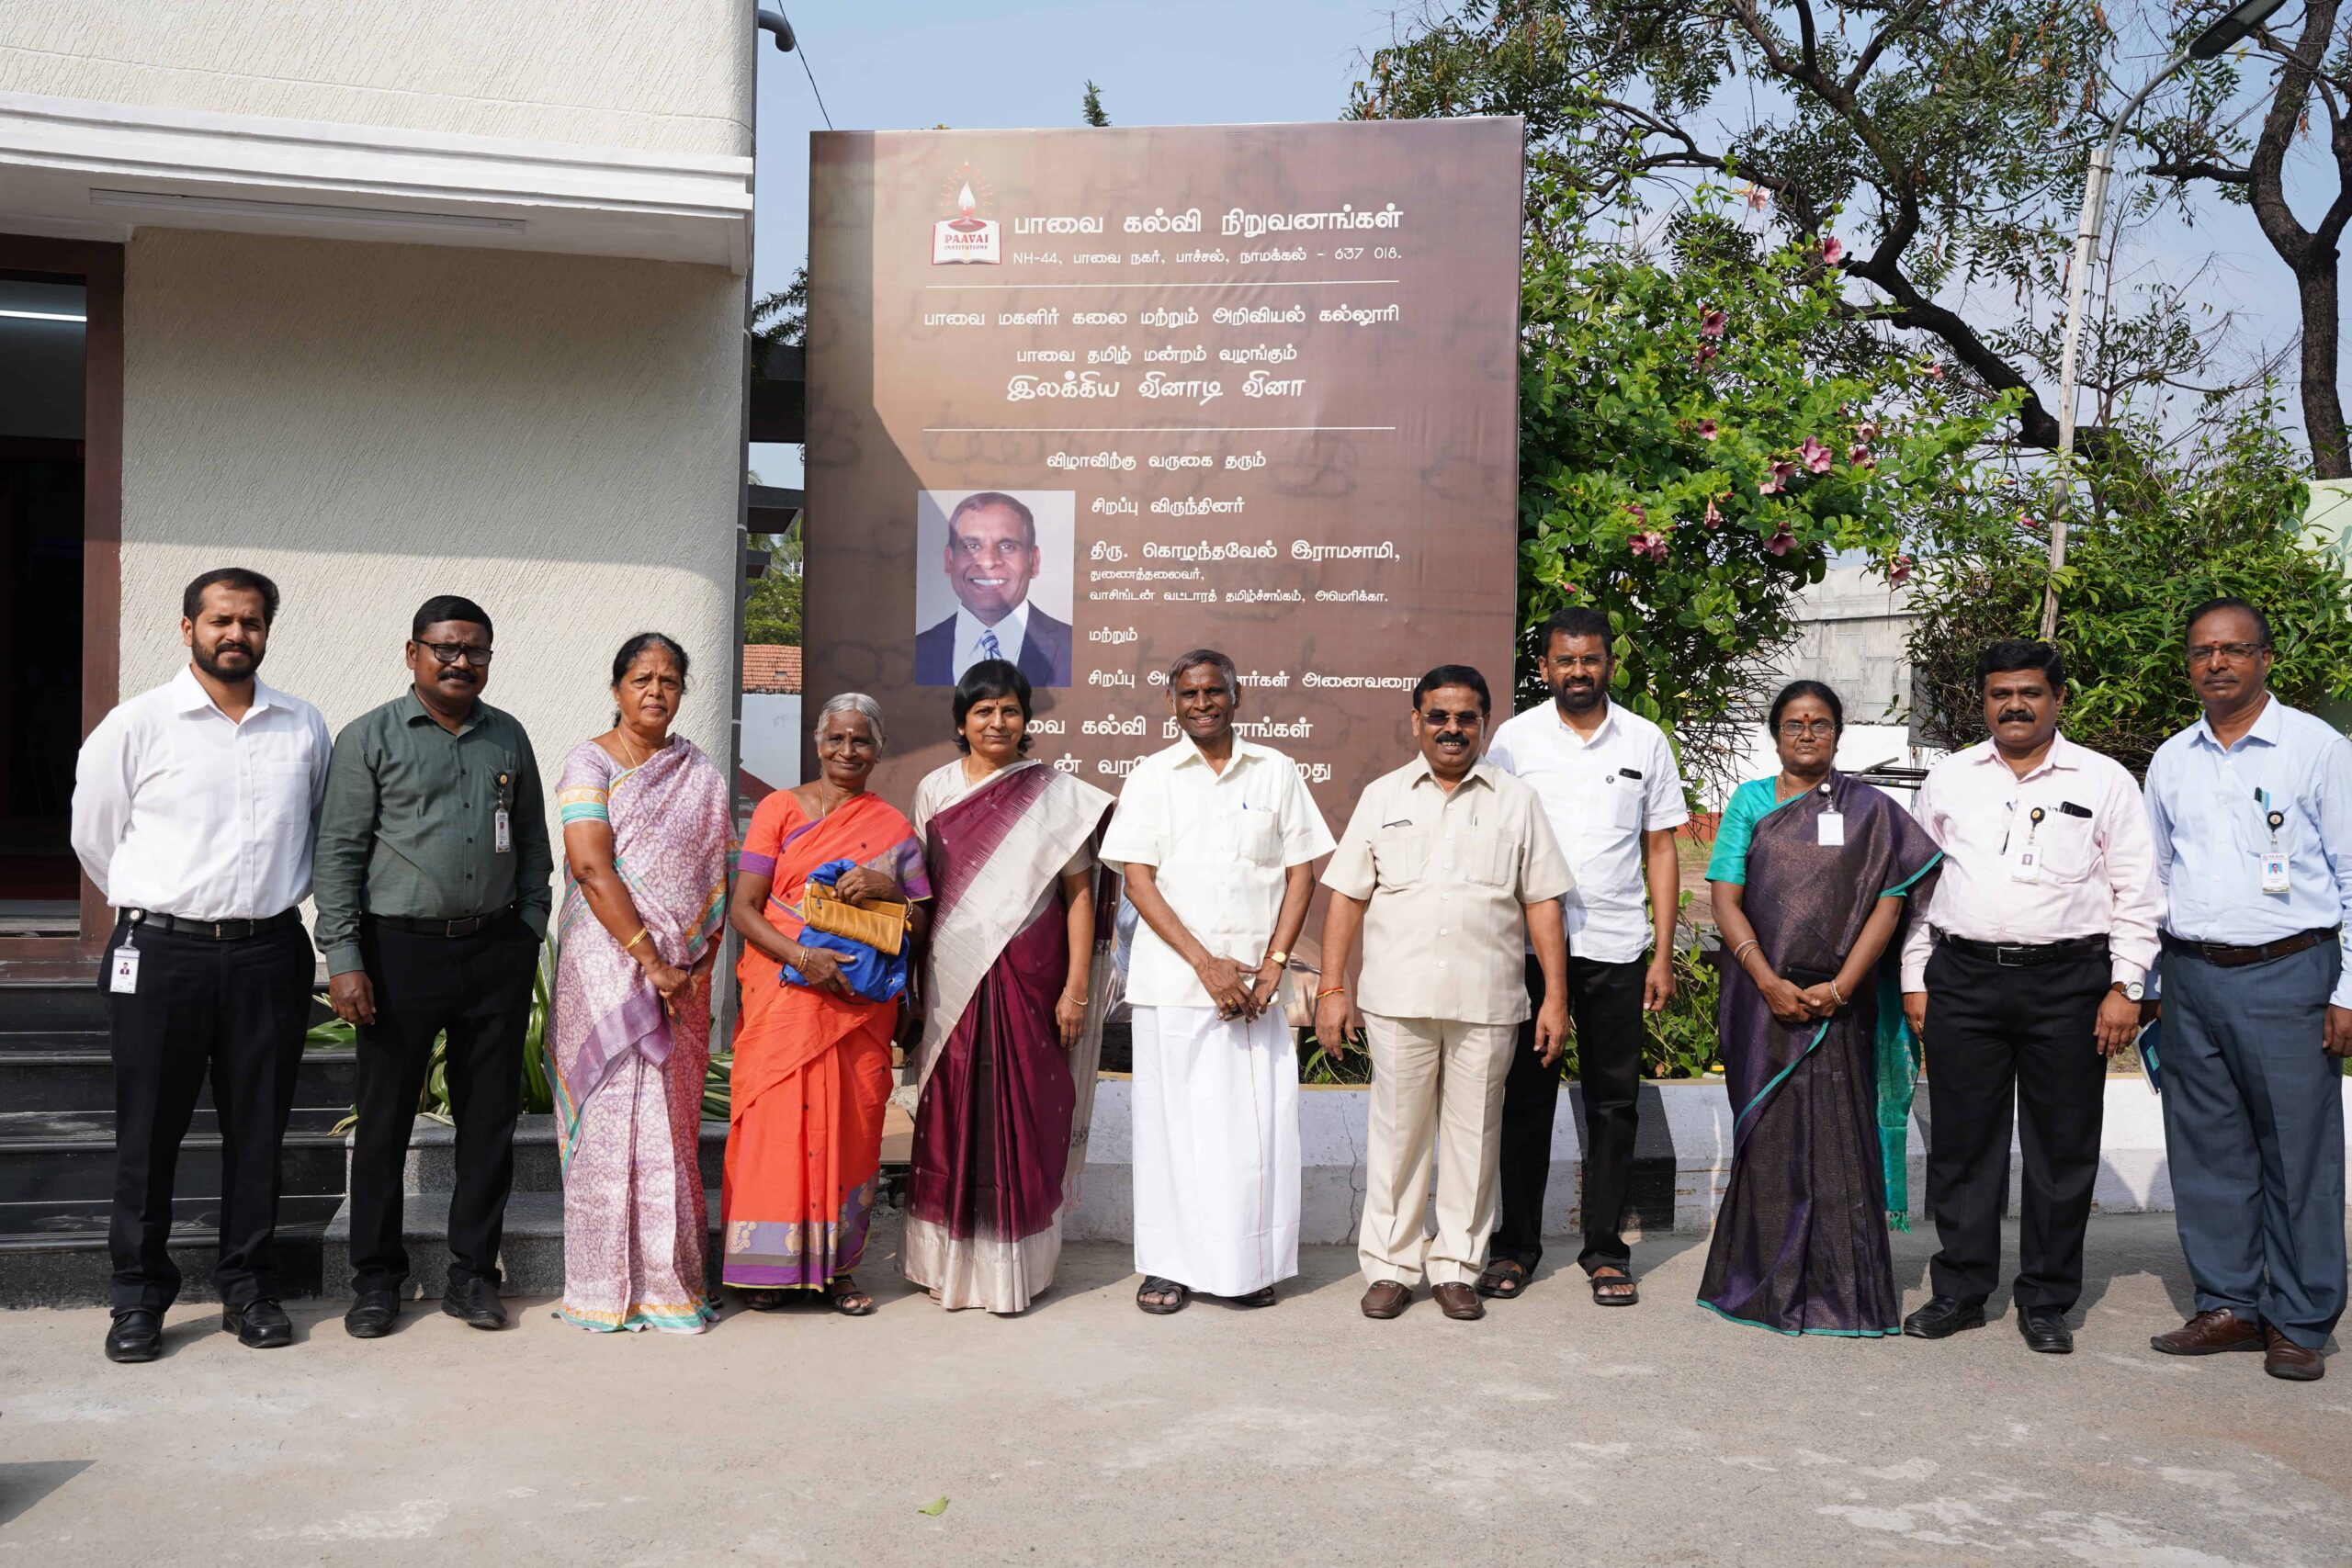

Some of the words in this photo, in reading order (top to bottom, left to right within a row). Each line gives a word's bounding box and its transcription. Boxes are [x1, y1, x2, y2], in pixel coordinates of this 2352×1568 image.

[1014, 216, 1103, 234] பாவை
[1123, 207, 1202, 233] கல்வி
[1221, 202, 1404, 238] நிறுவனங்கள்
[944, 233, 989, 243] PAAVAI
[1012, 252, 1063, 266] NH-44,
[1073, 253, 1121, 265] பாவை
[1130, 249, 1166, 265] நகர்,
[1176, 248, 1230, 264] பாச்சல்,
[1239, 246, 1307, 265] நாமக்கல்
[1334, 247, 1364, 260] 637
[1374, 246, 1402, 259] 018.
[924, 312, 986, 326] பாவை
[998, 307, 1060, 325] மகளிர்
[1071, 312, 1128, 325] கலை
[1140, 306, 1199, 329] மற்றும்
[1212, 304, 1306, 326] அறிவியல்
[1318, 303, 1399, 327] கல்லூரி
[1016, 350, 1076, 363] பாவை
[1087, 344, 1132, 366] தமிழ்
[1144, 344, 1207, 364] மன்றம்
[1218, 343, 1297, 365] வழங்கும்
[1006, 369, 1120, 402] இலக்கிய
[1137, 370, 1224, 406] வினாடி
[1241, 369, 1306, 399] வினா
[1046, 451, 1136, 471] விழாவிற்கு
[1148, 456, 1214, 471] வருகை
[1224, 450, 1267, 471] தரும்
[1091, 496, 1138, 516] சிறப்பு
[1149, 496, 1246, 517] விருந்தினர்
[1090, 540, 1128, 562] திரு.
[1142, 539, 1278, 561] கொழந்தவேல்
[1291, 539, 1400, 562] இராமசாமி,
[1090, 567, 1204, 582] துணைத்தலைவர்,
[1089, 588, 1156, 601] வாசிங்டன்
[1163, 588, 1217, 604] வட்டாரத்
[1225, 588, 1306, 604] தமிழ்ச்சங்கம்,
[1314, 589, 1388, 602] அமெரிக்கா.
[1089, 626, 1138, 645] மற்றும்
[1088, 669, 1136, 689] சிறப்பு
[1081, 713, 1147, 736] கல்வி
